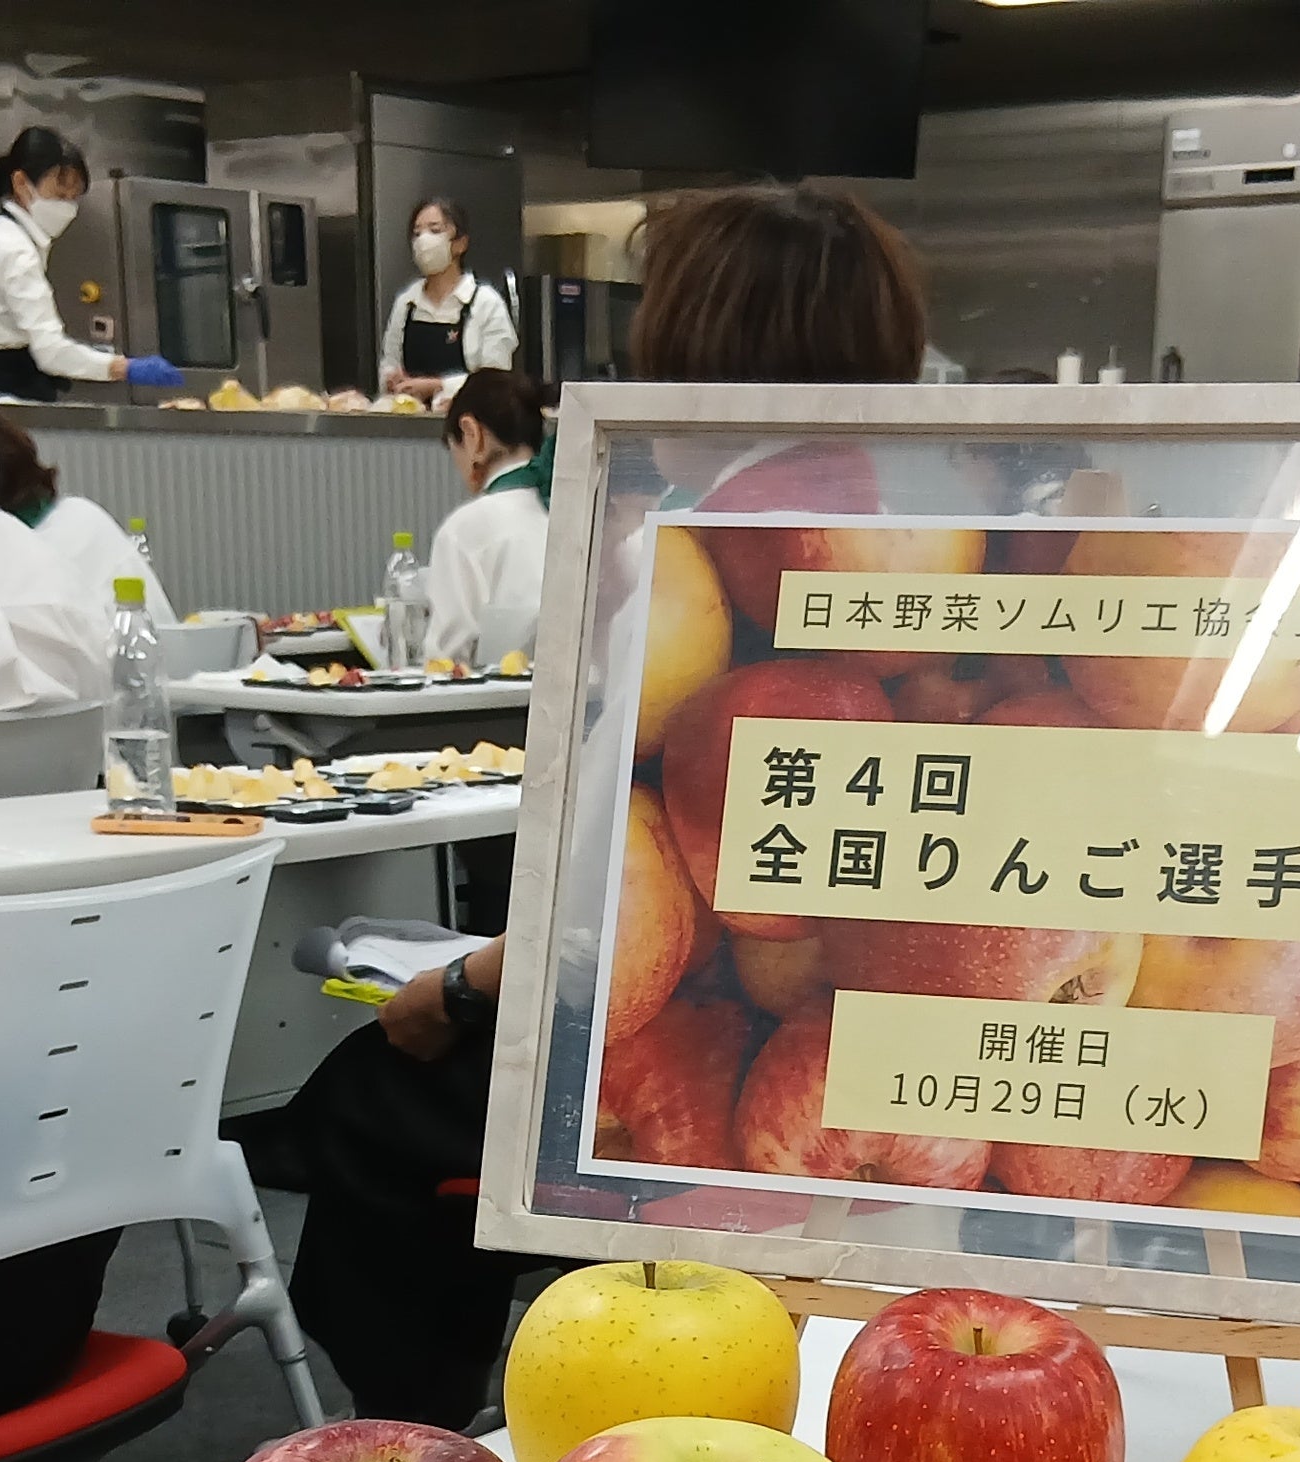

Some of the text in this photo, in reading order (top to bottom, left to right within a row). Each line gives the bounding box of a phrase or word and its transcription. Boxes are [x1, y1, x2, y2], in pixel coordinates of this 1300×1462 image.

[760, 746, 973, 816] 第4回
[978, 1022, 1111, 1068] 開催日
